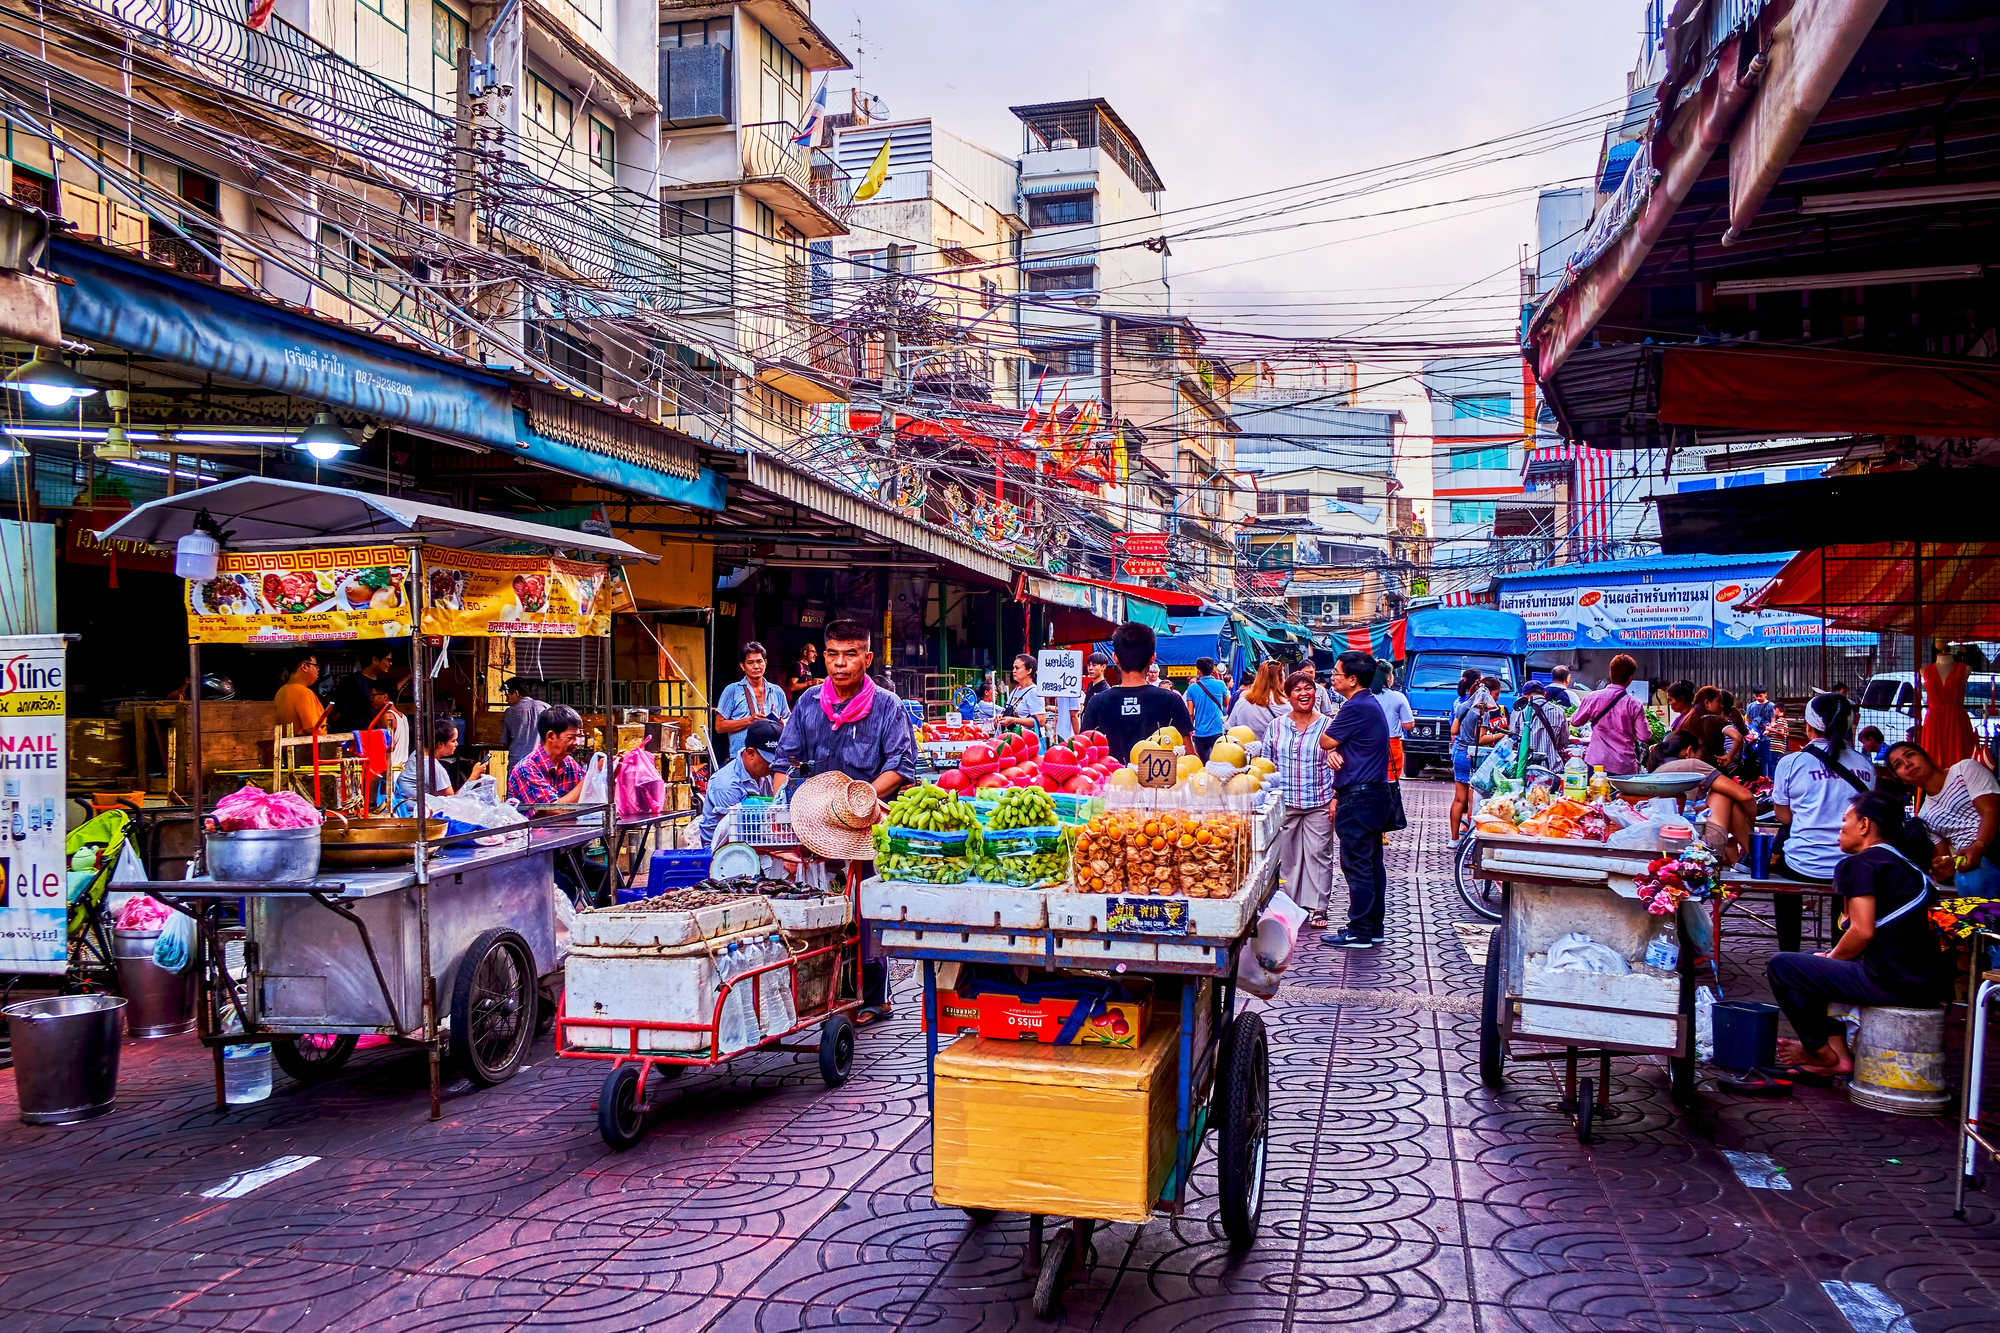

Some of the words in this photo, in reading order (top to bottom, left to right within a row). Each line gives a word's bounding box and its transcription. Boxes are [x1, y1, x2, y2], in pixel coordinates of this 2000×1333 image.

[285, 346, 318, 371] เจริญดี
[321, 354, 344, 377] ผ้าใบ
[356, 369, 413, 397] 087-9236289
[467, 602, 488, 611] 50.-
[1603, 588, 1709, 609] วุ้นผงสำหรับทำขนม
[271, 616, 287, 625] ขาหมู
[293, 614, 333, 622] 50.-/100.-
[1619, 624, 1709, 640] ตราปลาตะเพียนทอง
[1769, 636, 1834, 644] PLATAPIANTOG
[0, 753, 58, 770] HITE
[16, 863, 59, 898] ele
[1017, 1016, 1042, 1029] miss
